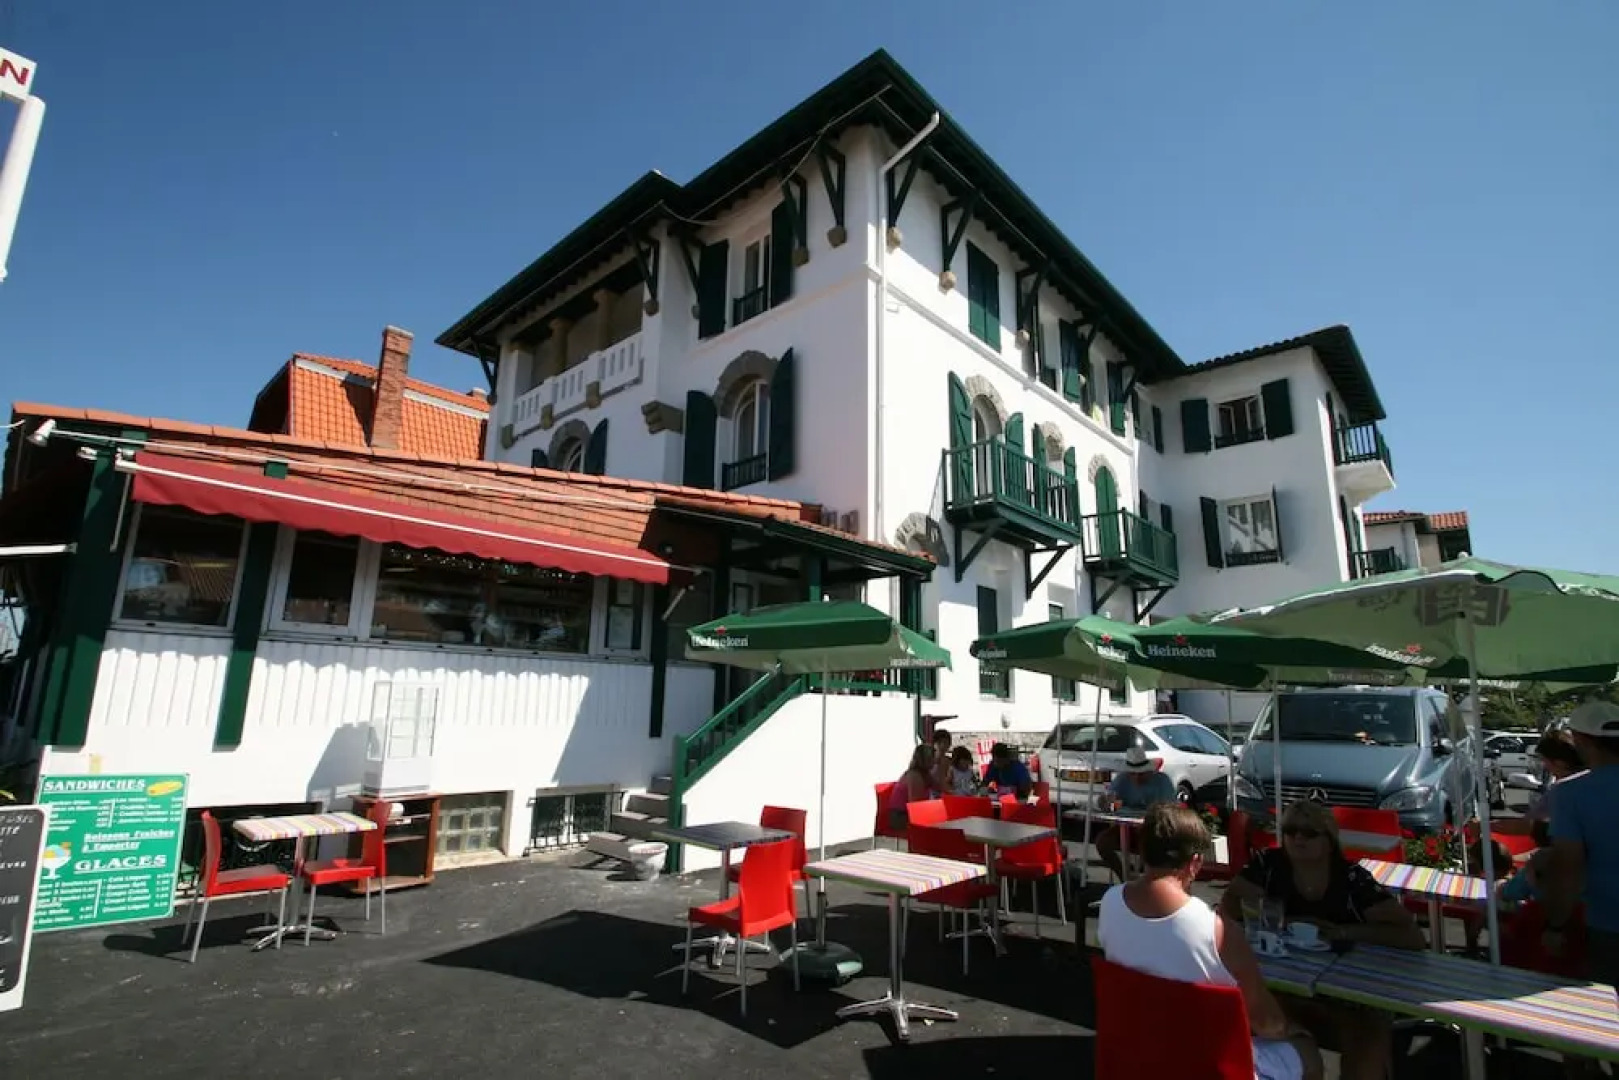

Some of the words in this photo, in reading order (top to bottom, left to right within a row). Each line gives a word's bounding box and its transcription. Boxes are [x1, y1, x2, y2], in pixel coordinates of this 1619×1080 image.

[1149, 645, 1216, 659] Heineken
[44, 779, 145, 791] SANDWICHES
[75, 854, 167, 871] GLACES
